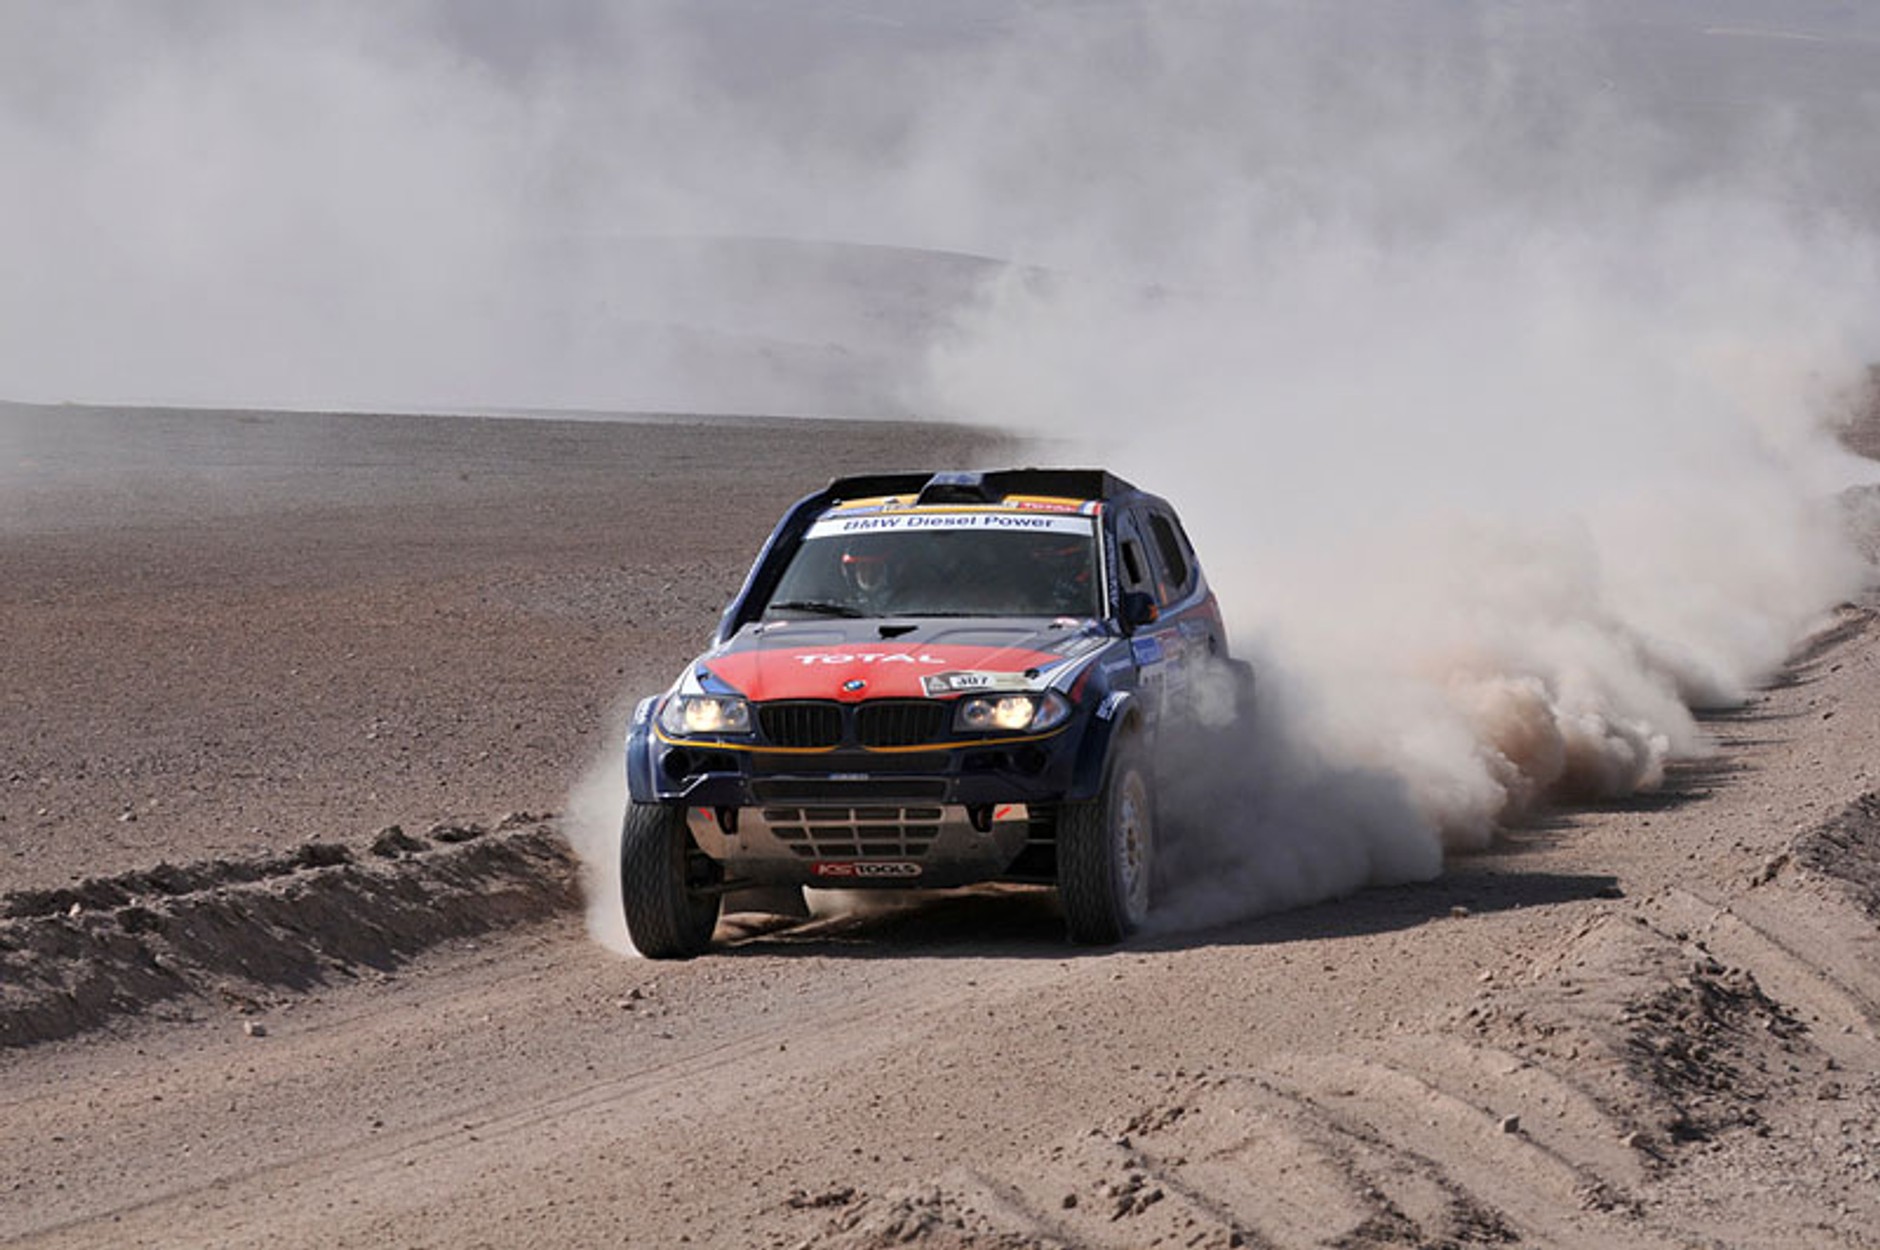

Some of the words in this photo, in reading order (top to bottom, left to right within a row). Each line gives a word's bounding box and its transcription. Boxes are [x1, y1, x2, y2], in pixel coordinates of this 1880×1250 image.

[843, 517, 901, 531] BMW
[908, 516, 976, 527] Diesel
[985, 516, 1054, 527] Power
[794, 653, 946, 664] TOTAL
